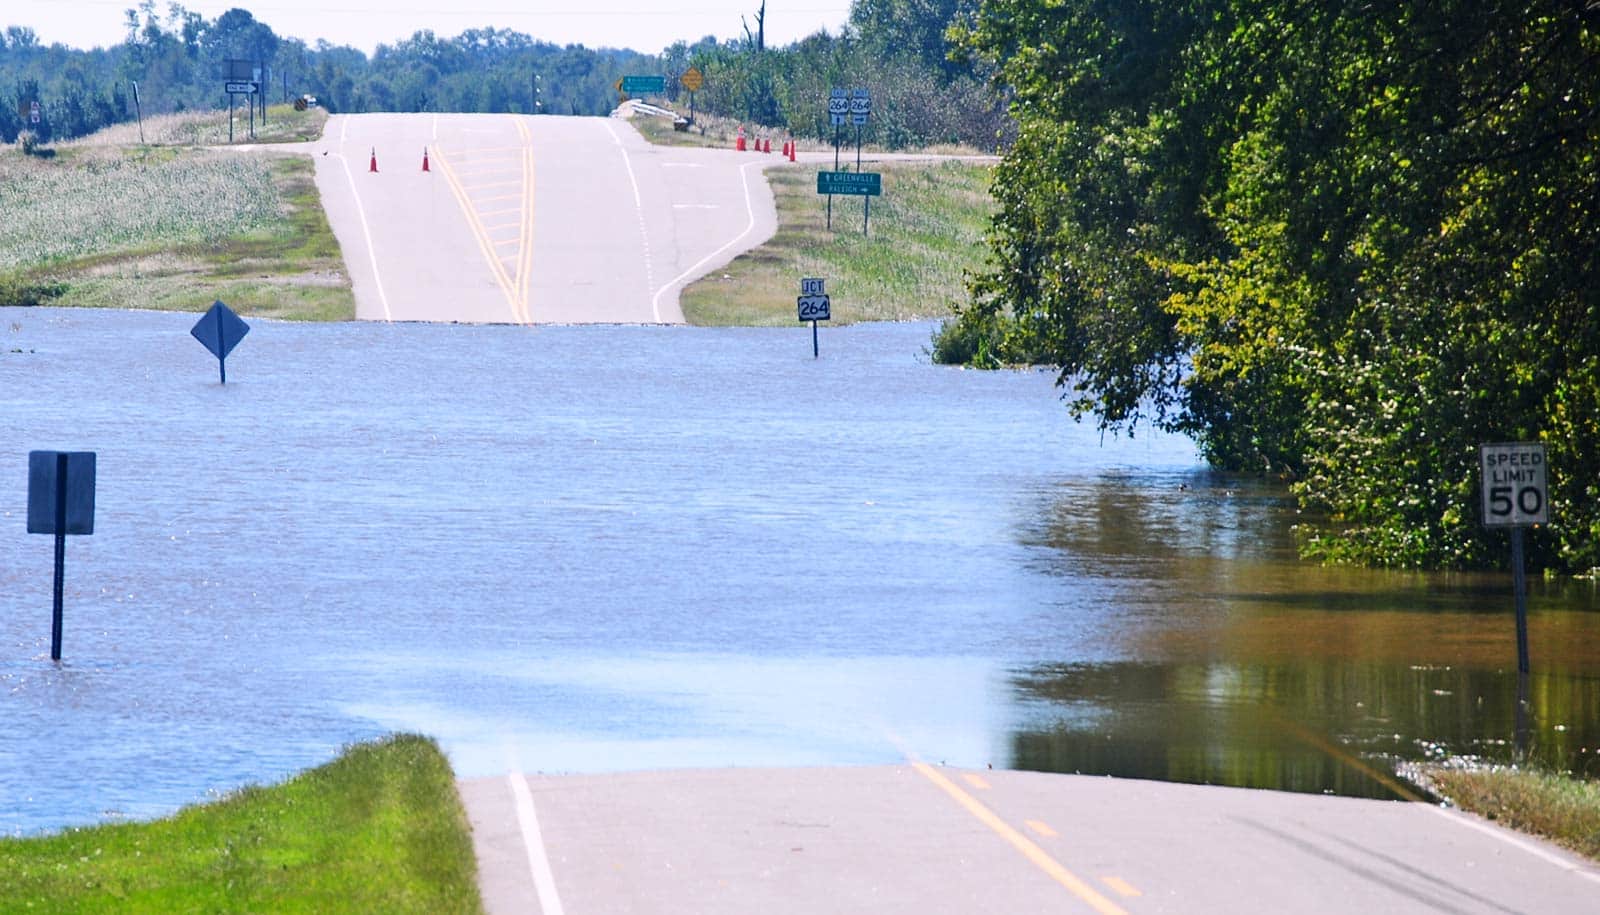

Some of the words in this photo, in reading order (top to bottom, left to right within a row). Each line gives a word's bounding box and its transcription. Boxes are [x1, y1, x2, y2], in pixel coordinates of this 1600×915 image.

[830, 100, 848, 110] 264
[852, 100, 871, 110] 264
[833, 174, 873, 183] GREENVILLE
[829, 184, 857, 193] RALEIGH
[804, 281, 822, 292] JCT
[800, 300, 828, 315] 264
[1487, 452, 1542, 466] SPEED
[1493, 470, 1536, 483] LIMIT
[1489, 486, 1543, 516] 50
